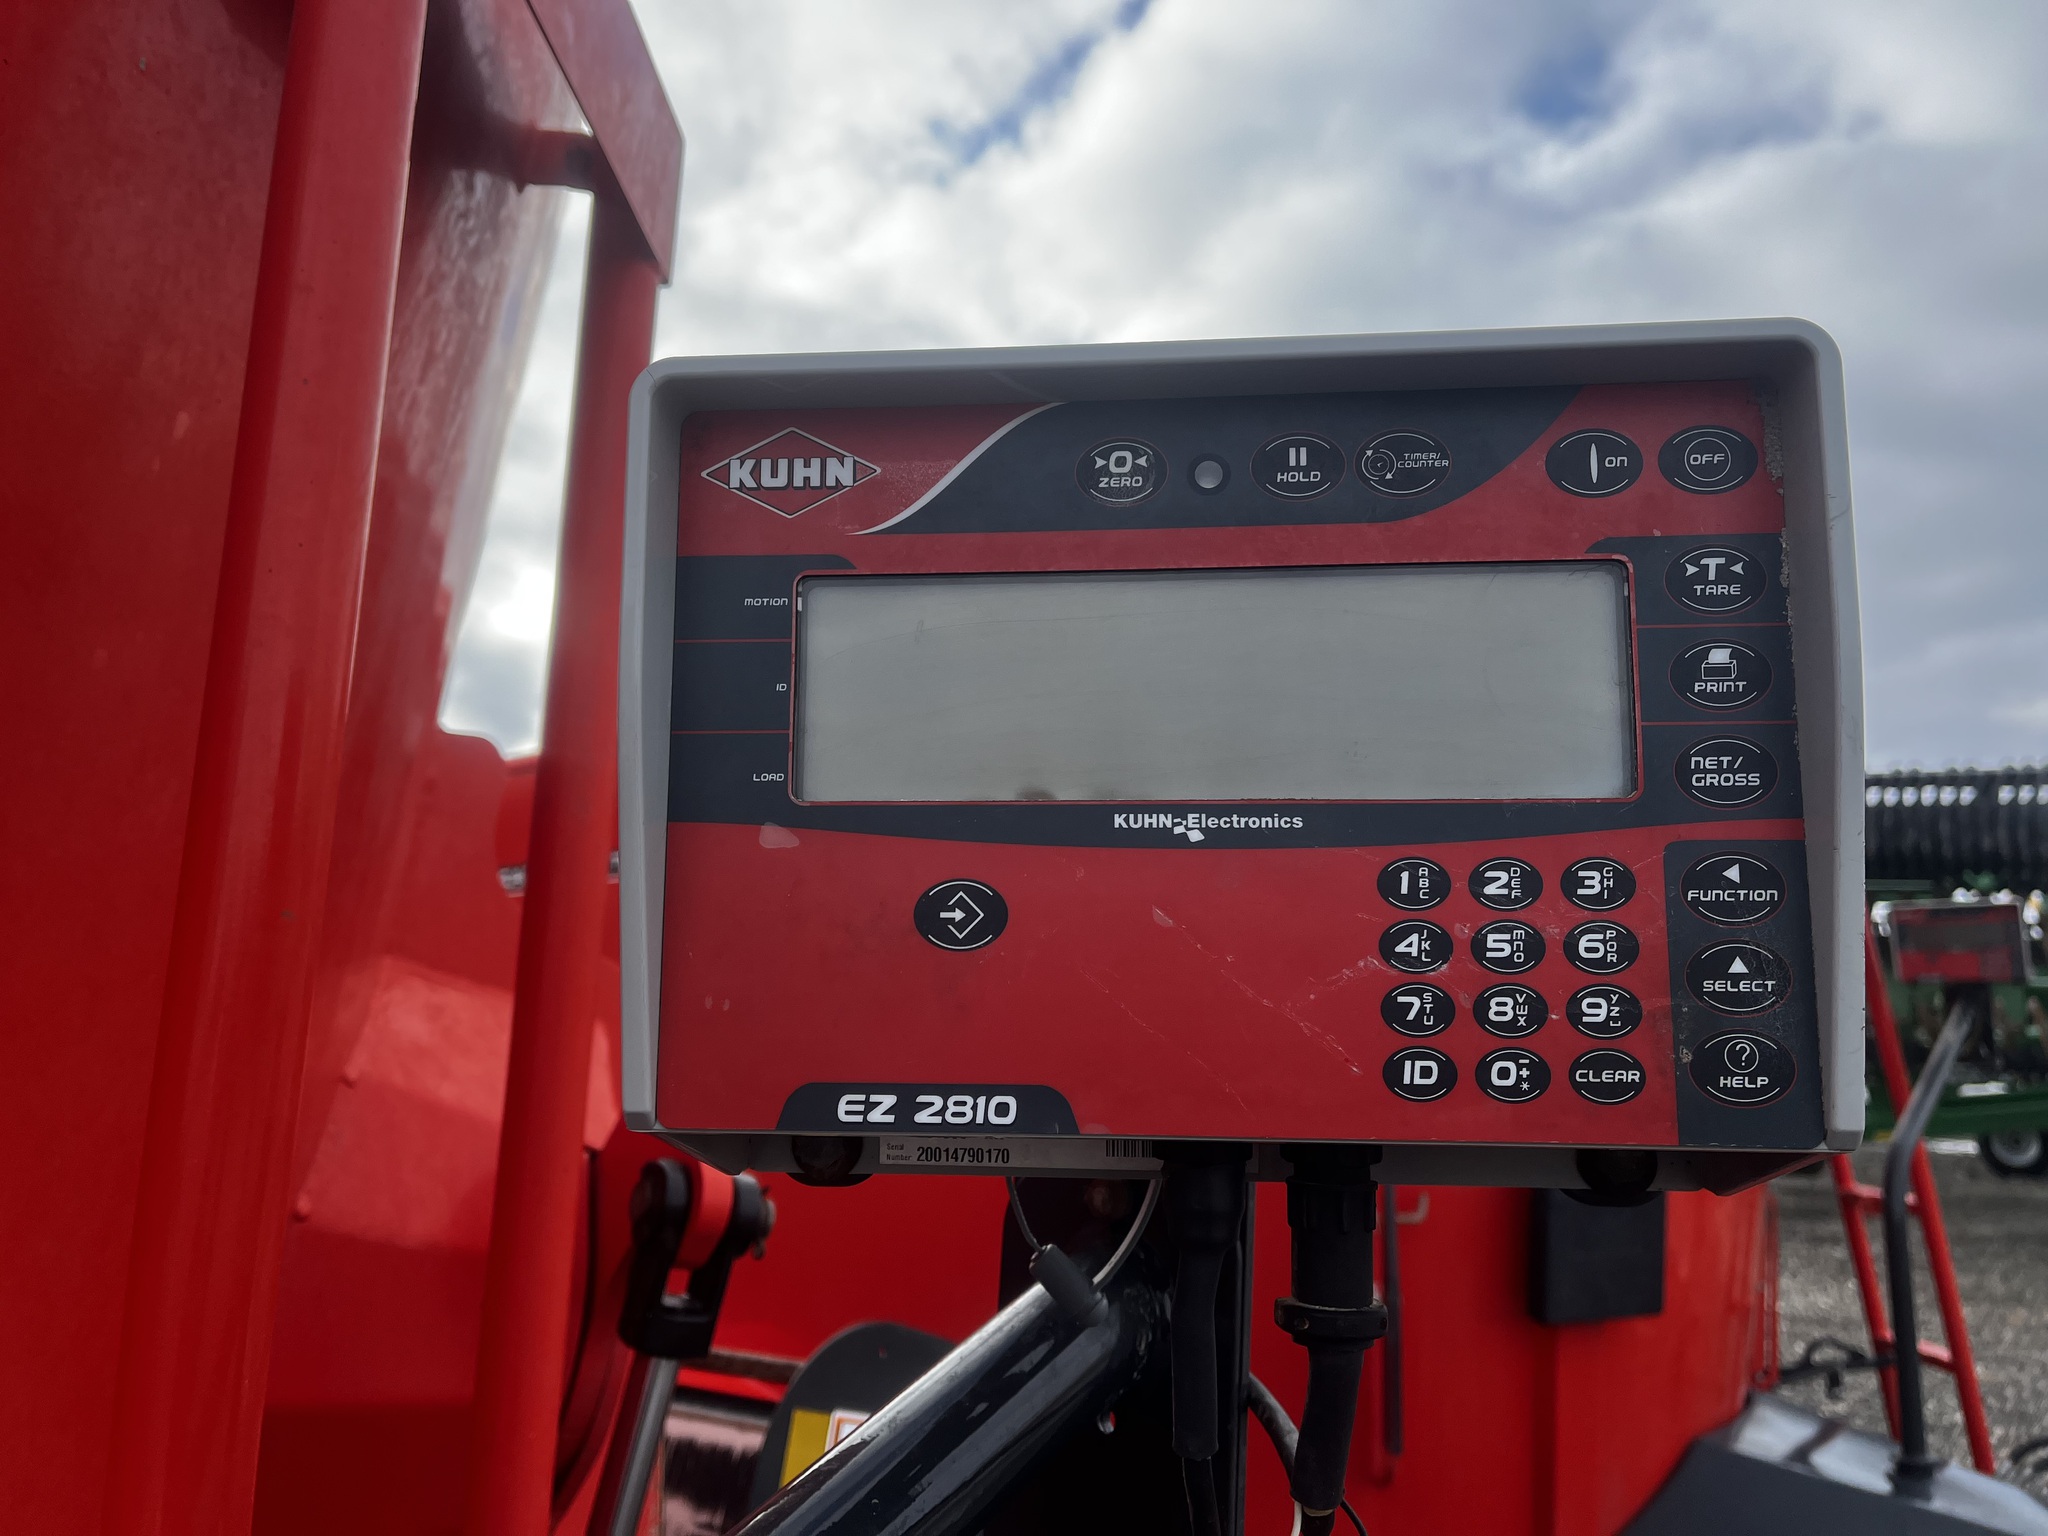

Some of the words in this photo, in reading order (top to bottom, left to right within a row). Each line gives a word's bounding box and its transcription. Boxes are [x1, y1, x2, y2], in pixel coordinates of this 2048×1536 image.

[1403, 452, 1441, 460] TIMER/
[1689, 453, 1725, 465] OFF
[1397, 460, 1449, 468] COUNTER
[728, 456, 857, 489] KUHN
[1276, 471, 1321, 483] HOLD
[1098, 475, 1143, 488] ZERO
[1693, 584, 1741, 596] TARE
[744, 597, 789, 607] MOTION
[775, 683, 788, 692] ID
[1694, 681, 1747, 693] PRINT
[1690, 756, 1744, 770] NET/
[753, 773, 785, 782] LOAD
[1691, 773, 1761, 787] GROSS
[1113, 813, 1173, 829] KUHN
[1187, 813, 1304, 829] Electronics
[1400, 871, 1409, 895] 1
[1483, 871, 1510, 895] 2
[1576, 870, 1602, 895] 3
[1687, 889, 1778, 901] FUNCTION
[1394, 933, 1419, 957] 4
[1485, 933, 1512, 958] 5
[1578, 933, 1605, 959] 6
[1702, 981, 1776, 992] SELECT
[1396, 996, 1421, 1021] 7
[1488, 996, 1514, 1022] 8
[1581, 997, 1608, 1023] 9
[1402, 1060, 1439, 1085] ID
[1575, 1069, 1641, 1083] CLEAR
[1719, 1076, 1769, 1088] HELP
[837, 1094, 898, 1123] EZ
[913, 1095, 1017, 1125] 2810
[886, 1154, 912, 1162] Number
[916, 1146, 1010, 1164] 20014790170
